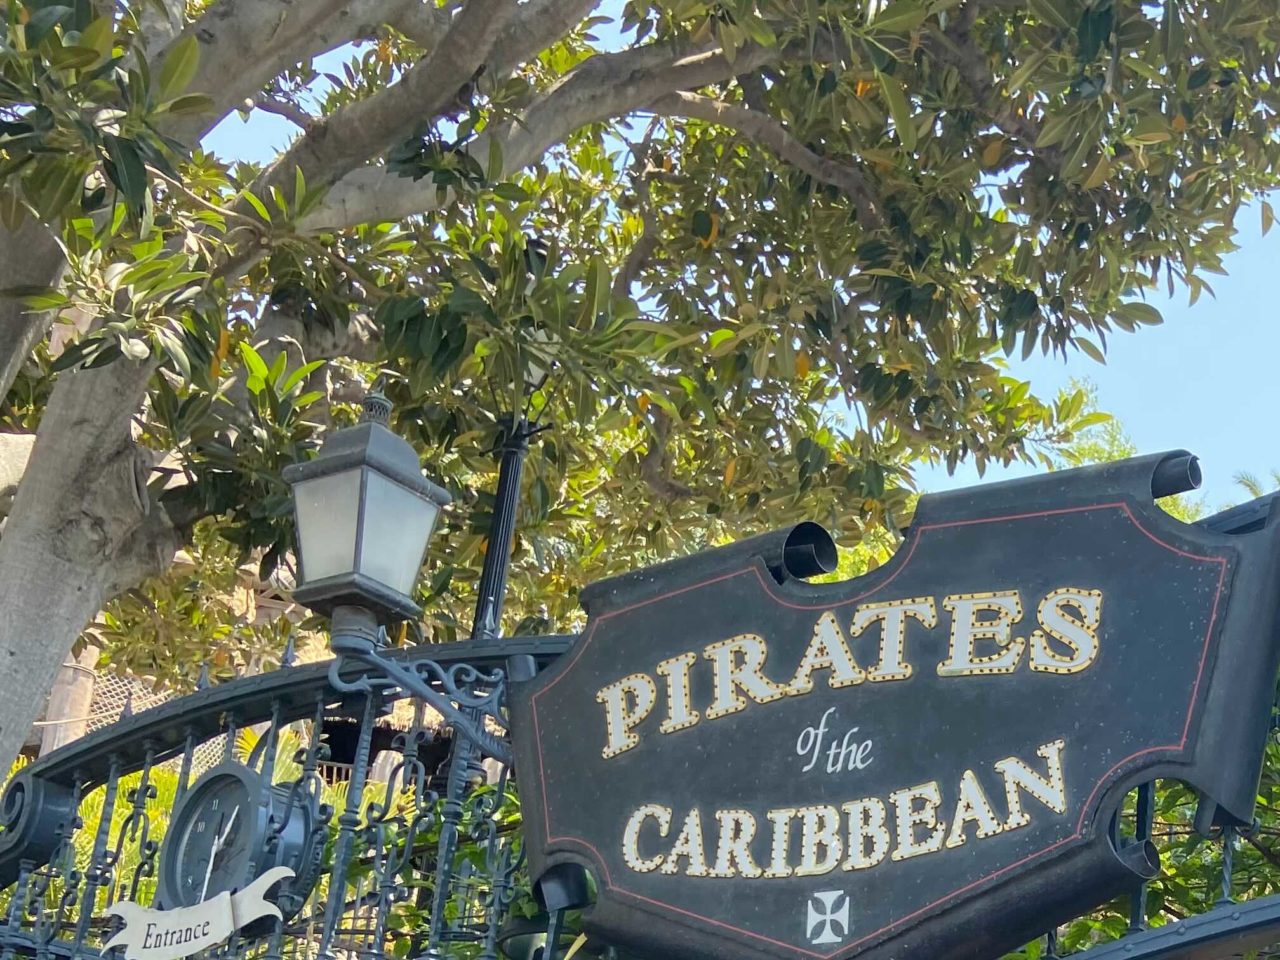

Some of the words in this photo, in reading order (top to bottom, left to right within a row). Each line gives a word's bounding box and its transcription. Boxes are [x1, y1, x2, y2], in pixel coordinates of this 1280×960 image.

[596, 587, 1103, 759] PIRATES
[796, 707, 835, 773] of
[825, 727, 874, 775] the
[621, 739, 1067, 879] CARIBBEAN
[142, 920, 210, 949] Entrance
